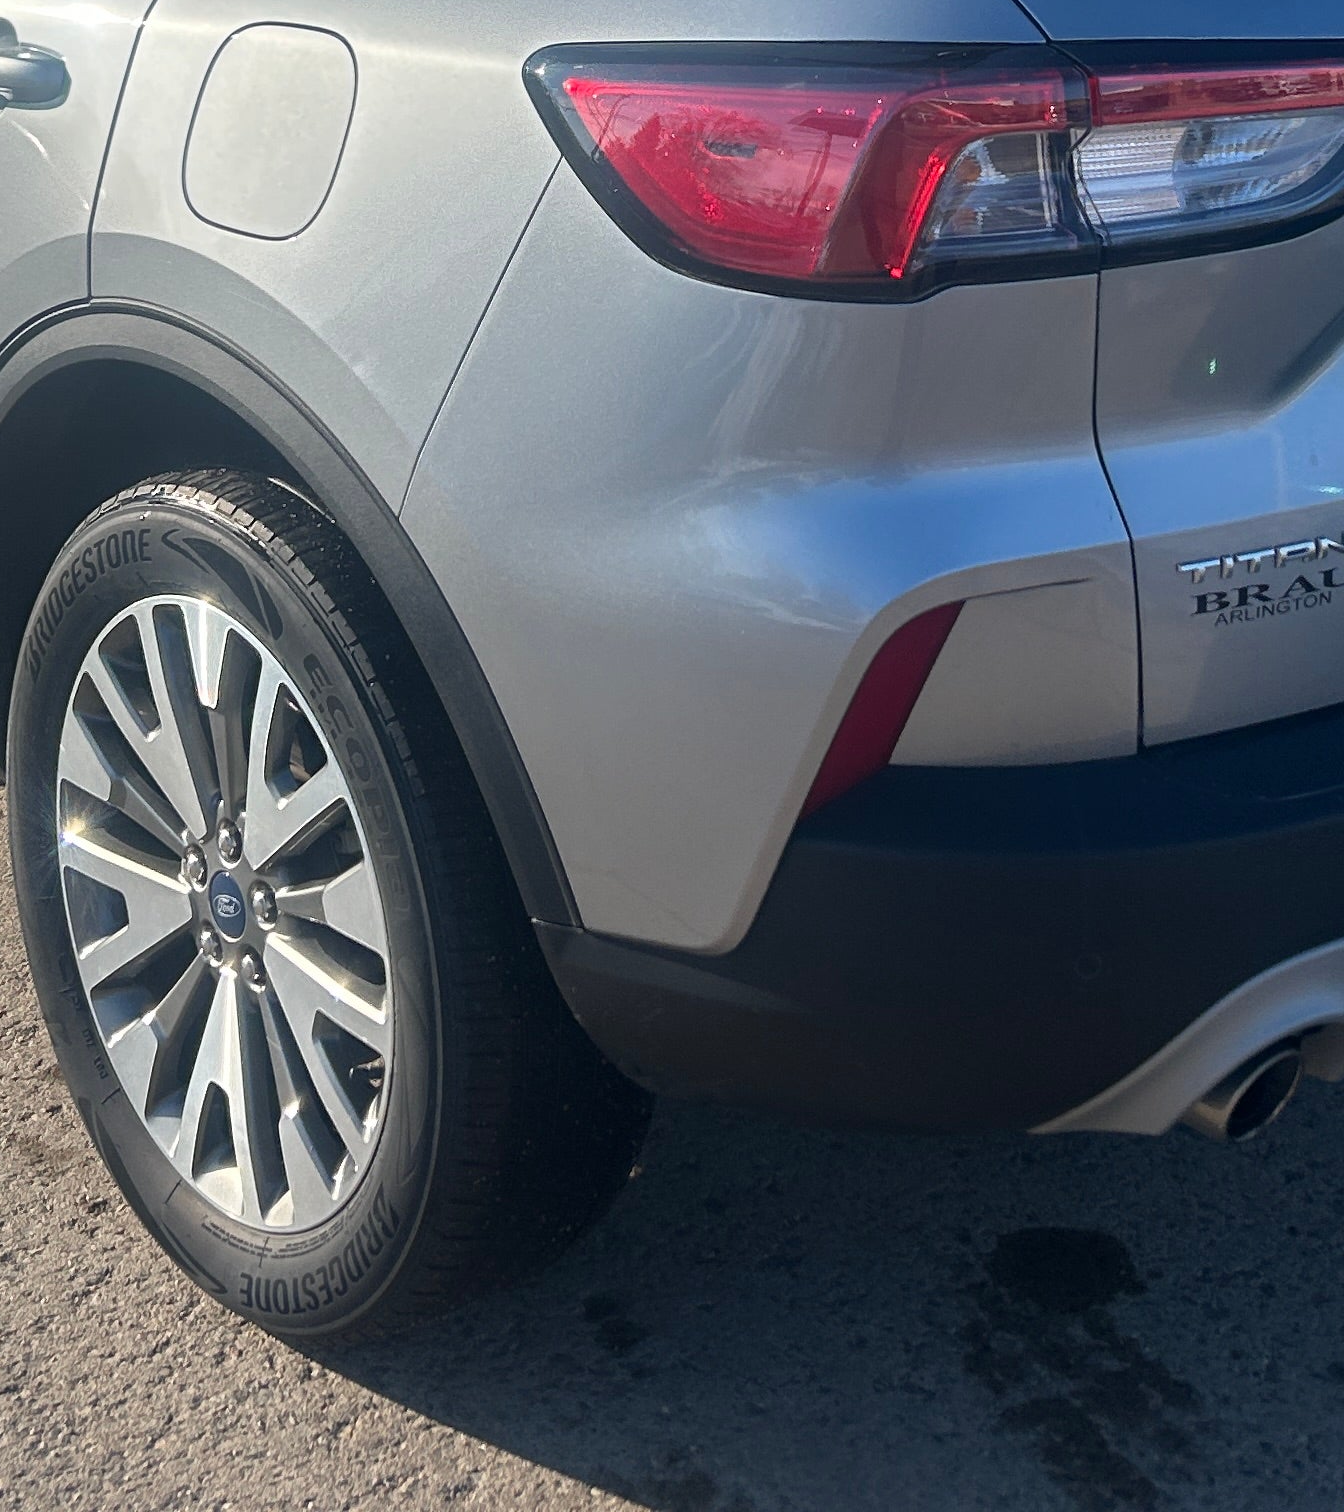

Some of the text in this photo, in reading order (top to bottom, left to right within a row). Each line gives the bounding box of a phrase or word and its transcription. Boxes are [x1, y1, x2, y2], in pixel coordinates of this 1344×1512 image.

[23, 528, 152, 684] BRIDGESTONE
[1214, 591, 1332, 627] ARLINGTON
[240, 1191, 400, 1316] BRIDGESTONE
